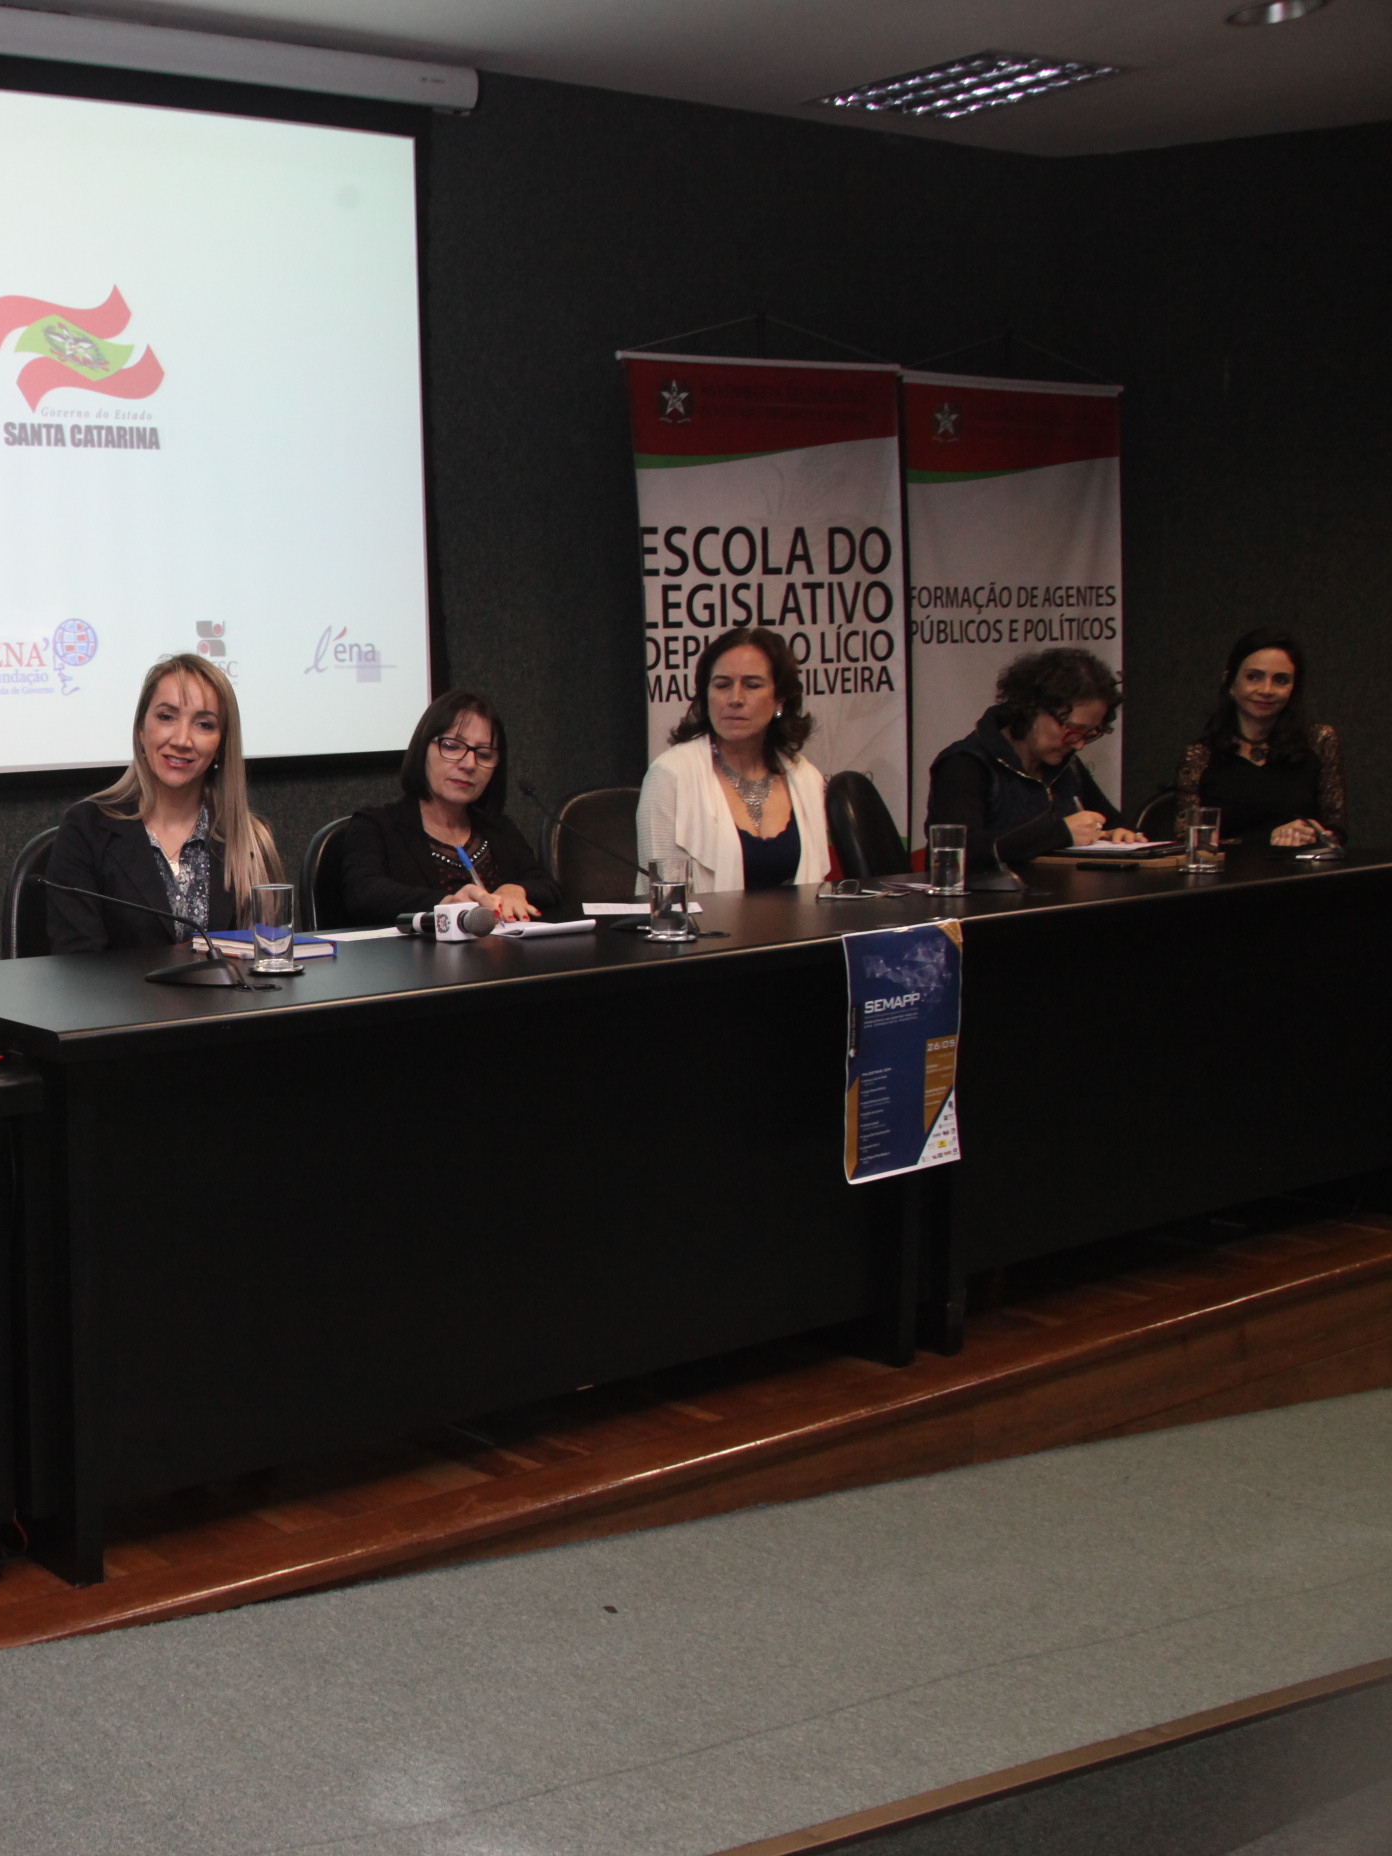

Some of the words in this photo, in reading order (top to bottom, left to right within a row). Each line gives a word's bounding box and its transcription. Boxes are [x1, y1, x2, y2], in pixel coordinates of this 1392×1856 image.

[40, 406, 90, 419] Governo
[95, 408, 109, 419] do
[114, 409, 153, 421] Estado
[3, 421, 66, 448] SANTA
[69, 424, 161, 450] CATARINA
[640, 526, 814, 577] ESCOLA
[828, 526, 892, 575] DO
[911, 582, 1012, 615] FORMAÇÃO
[1017, 586, 1039, 608] DE
[1042, 585, 1117, 608] AGENTES
[820, 624, 895, 664] LÍCIO
[911, 615, 1003, 644] PÚBLICOS
[1009, 619, 1019, 643] E
[1023, 613, 1117, 643] POLÍTICOS
[864, 992, 921, 1014] SEMAPP
